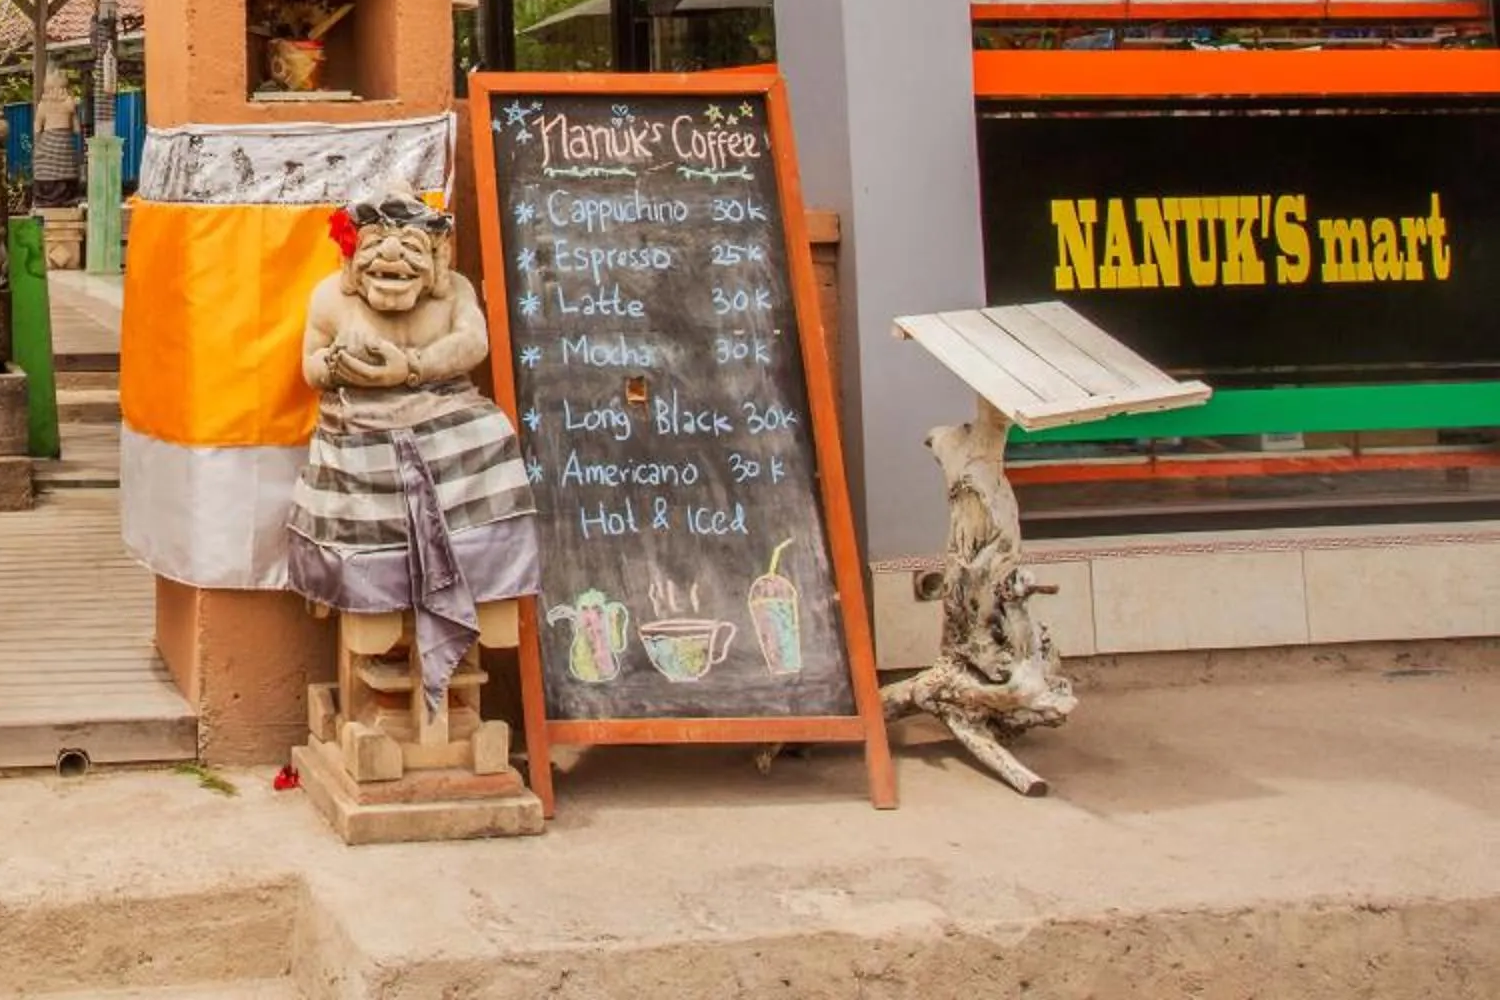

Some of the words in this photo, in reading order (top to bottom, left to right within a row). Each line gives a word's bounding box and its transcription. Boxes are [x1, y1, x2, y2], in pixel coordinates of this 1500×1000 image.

[671, 115, 762, 170] Coffee
[547, 188, 689, 233] Cappuchino
[554, 238, 672, 286] Espresso
[1050, 194, 1312, 291] NANUK'S
[1318, 191, 1452, 284] mart
[557, 283, 645, 318] Latte
[561, 333, 656, 367] Mocha
[563, 397, 632, 441] Long
[654, 389, 733, 436] Black
[561, 449, 699, 488] Americano
[581, 496, 639, 539] Hot
[652, 496, 670, 530] &
[687, 501, 749, 536] Iced
